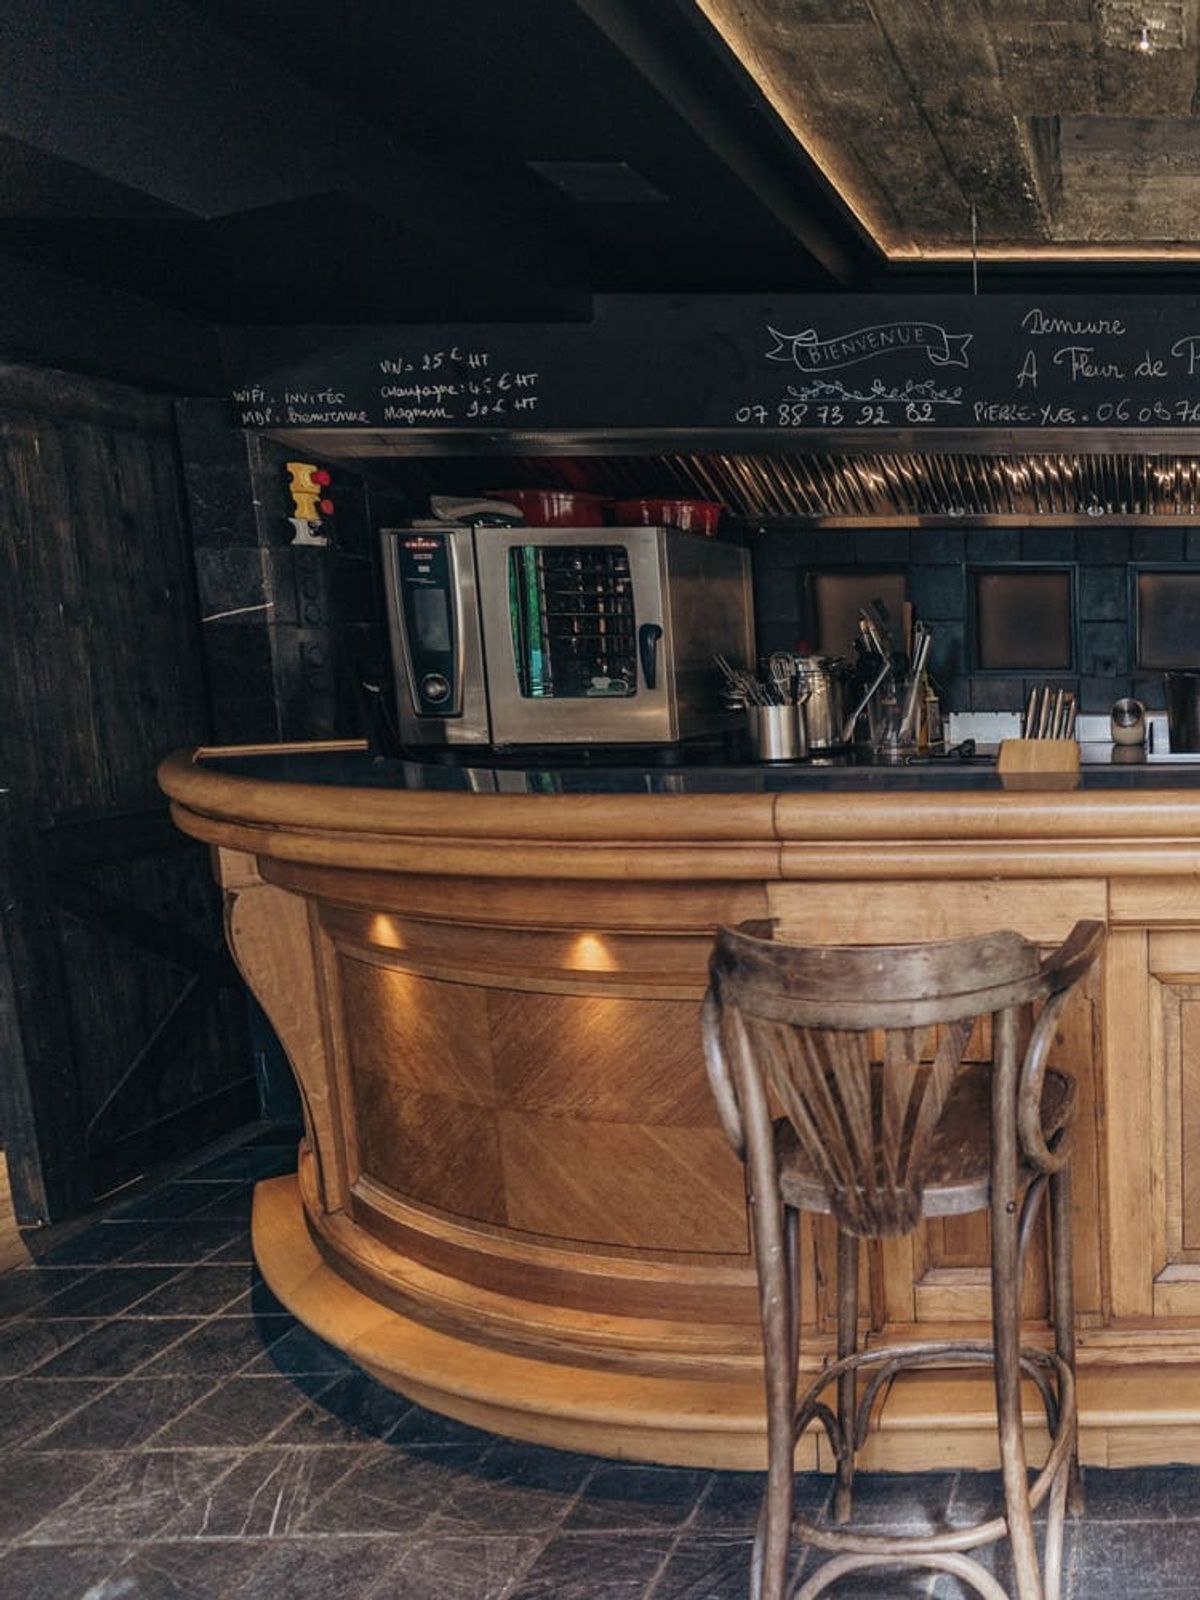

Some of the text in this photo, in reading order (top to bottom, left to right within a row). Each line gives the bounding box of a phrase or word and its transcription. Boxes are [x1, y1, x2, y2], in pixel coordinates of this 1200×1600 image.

[1020, 306, 1126, 335] Demeure
[808, 326, 925, 364] BIENVENUE
[467, 353, 490, 369] HT
[1053, 345, 1125, 382] Fleur
[1134, 350, 1168, 378] de
[514, 373, 538, 387] HT
[514, 397, 538, 411] HT
[736, 405, 768, 424] 07
[778, 402, 808, 426] 88
[816, 405, 844, 425] 73
[856, 406, 890, 425] 92
[1096, 398, 1130, 422] 06
